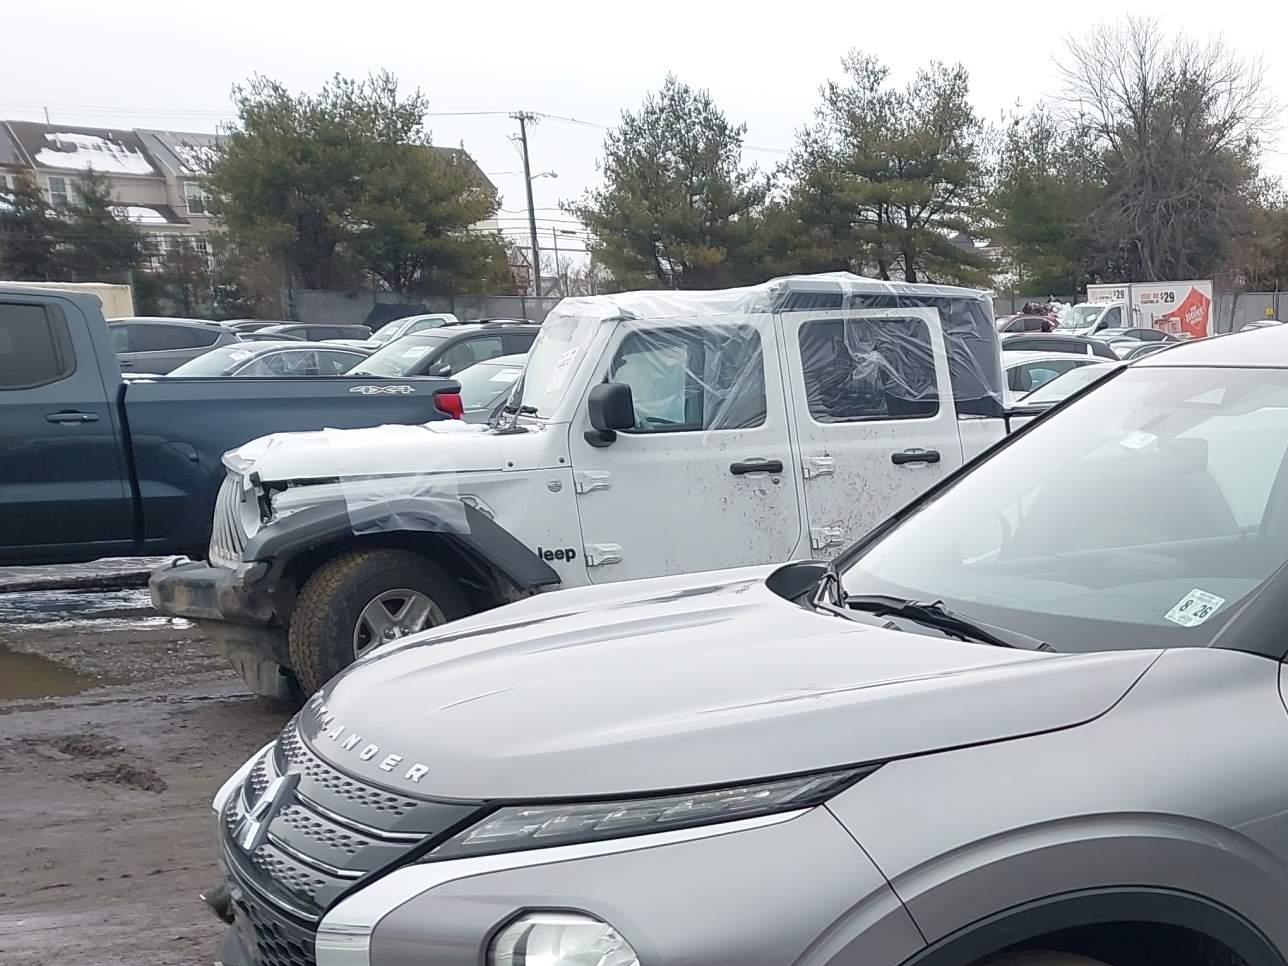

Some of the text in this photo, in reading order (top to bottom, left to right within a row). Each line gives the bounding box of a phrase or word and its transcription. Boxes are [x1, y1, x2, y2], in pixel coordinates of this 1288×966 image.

[1160, 291, 1175, 303] $29
[1179, 599, 1213, 619] 8 26
